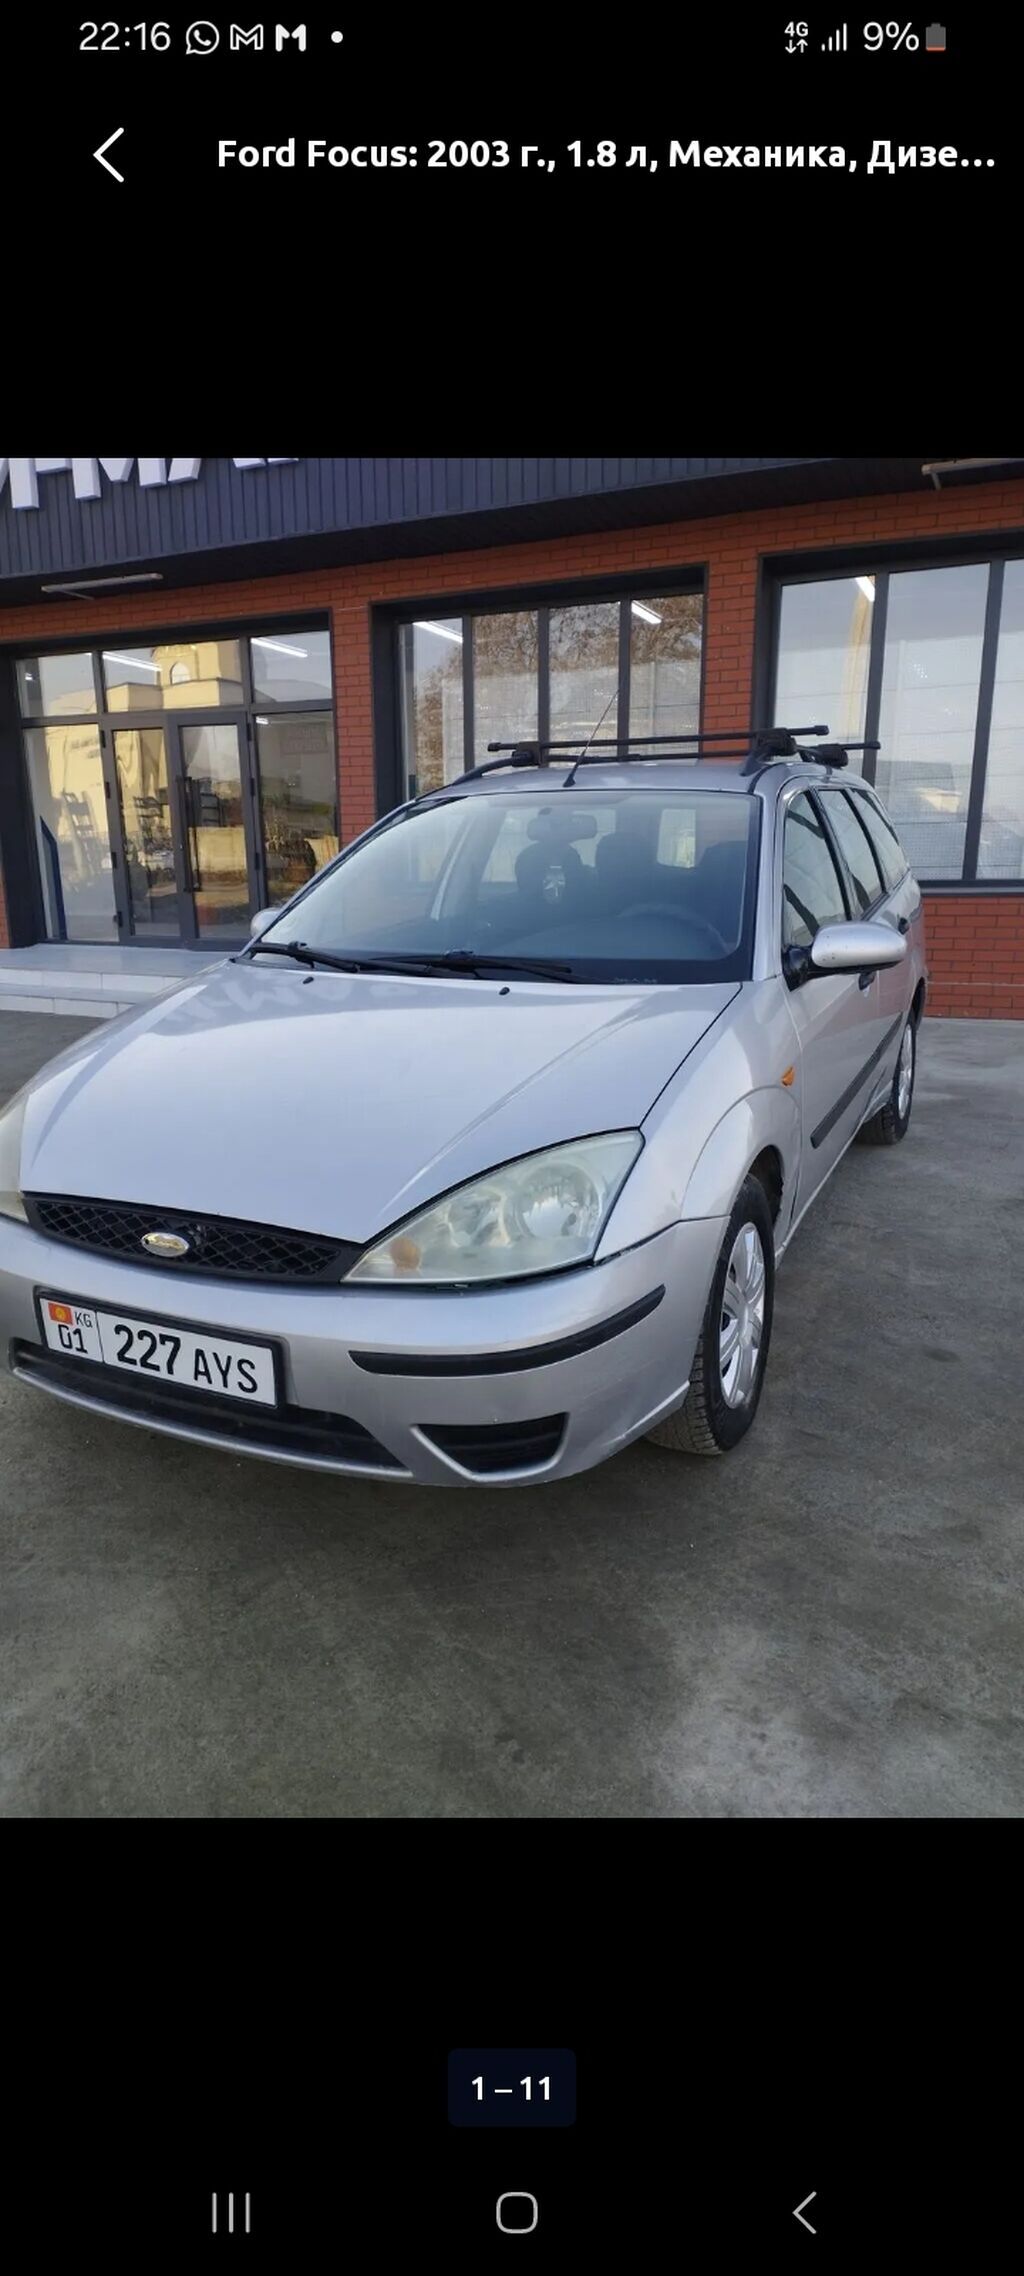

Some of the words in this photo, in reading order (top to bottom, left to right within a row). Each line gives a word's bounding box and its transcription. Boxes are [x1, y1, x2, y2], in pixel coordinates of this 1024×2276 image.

[74, 1311, 93, 1329] KG
[57, 1323, 88, 1355] 01
[113, 1323, 182, 1376] 227
[193, 1347, 258, 1394] AYS
